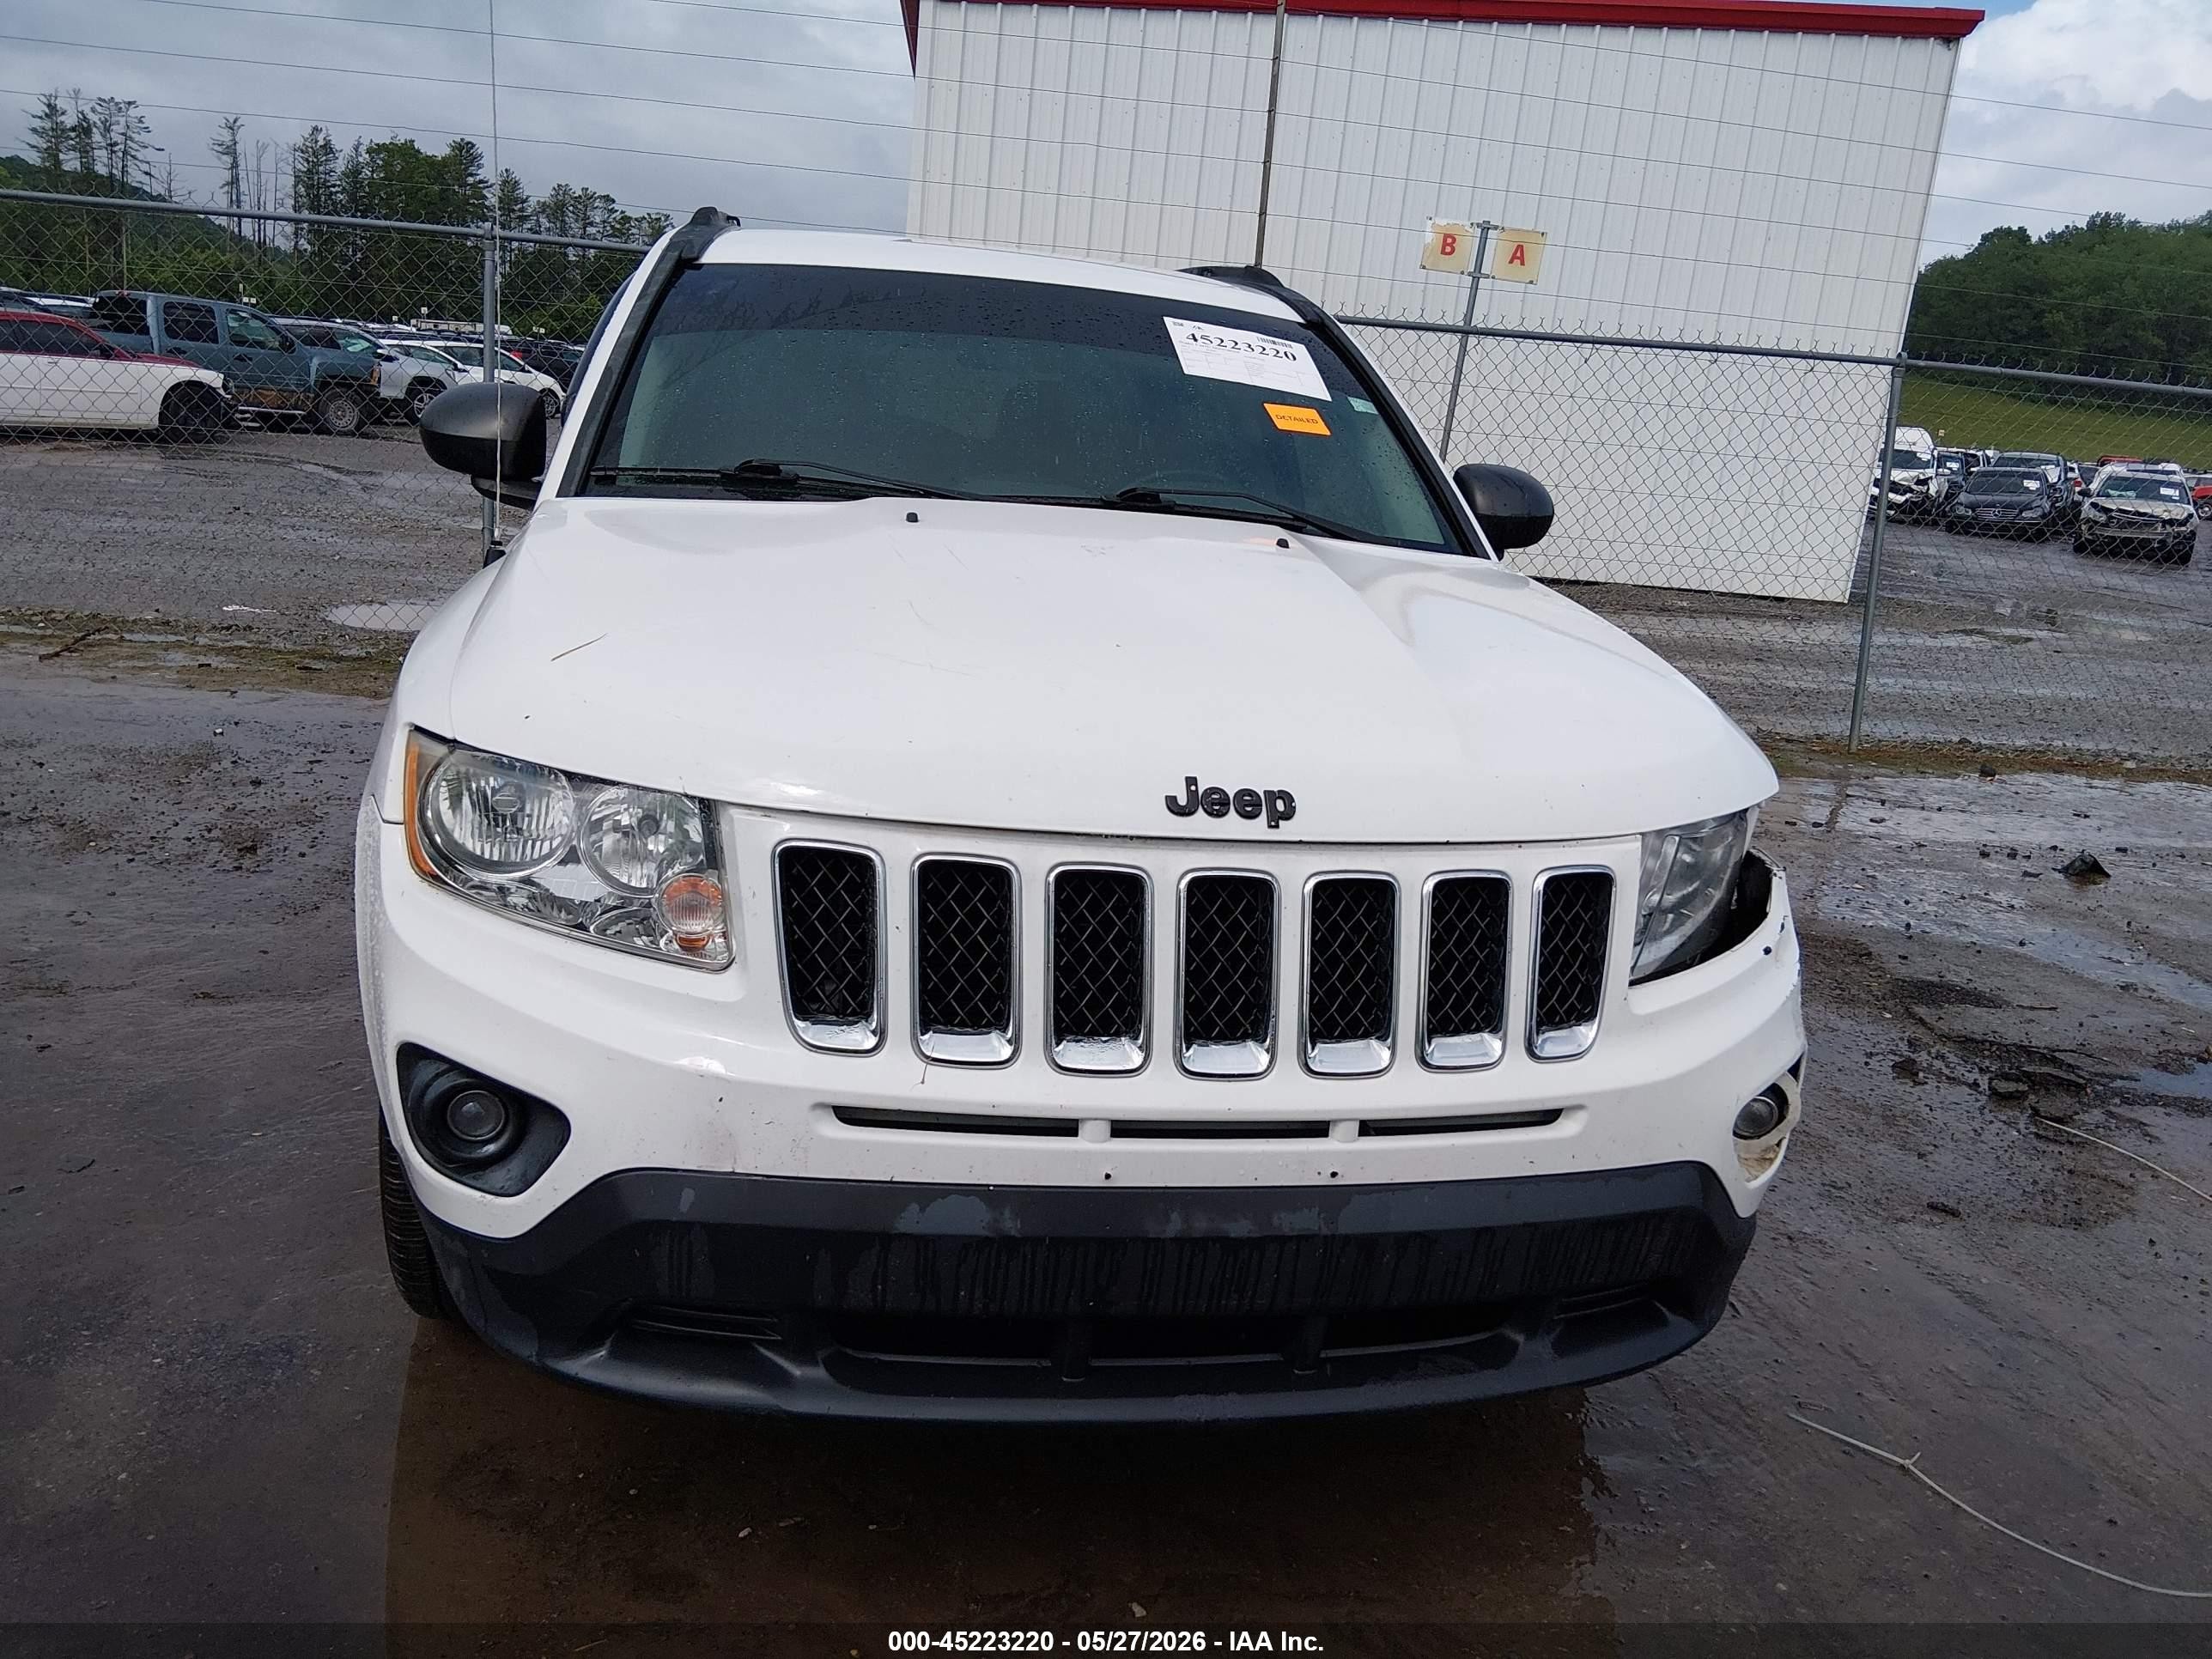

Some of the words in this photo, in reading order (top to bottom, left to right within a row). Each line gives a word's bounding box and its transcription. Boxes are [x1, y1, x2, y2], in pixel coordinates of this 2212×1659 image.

[1440, 233, 1457, 256] B
[1508, 244, 1526, 266] A
[1186, 331, 1297, 362] 45223220
[1275, 414, 1319, 425] DETAILED
[1165, 776, 1297, 830] Jeep
